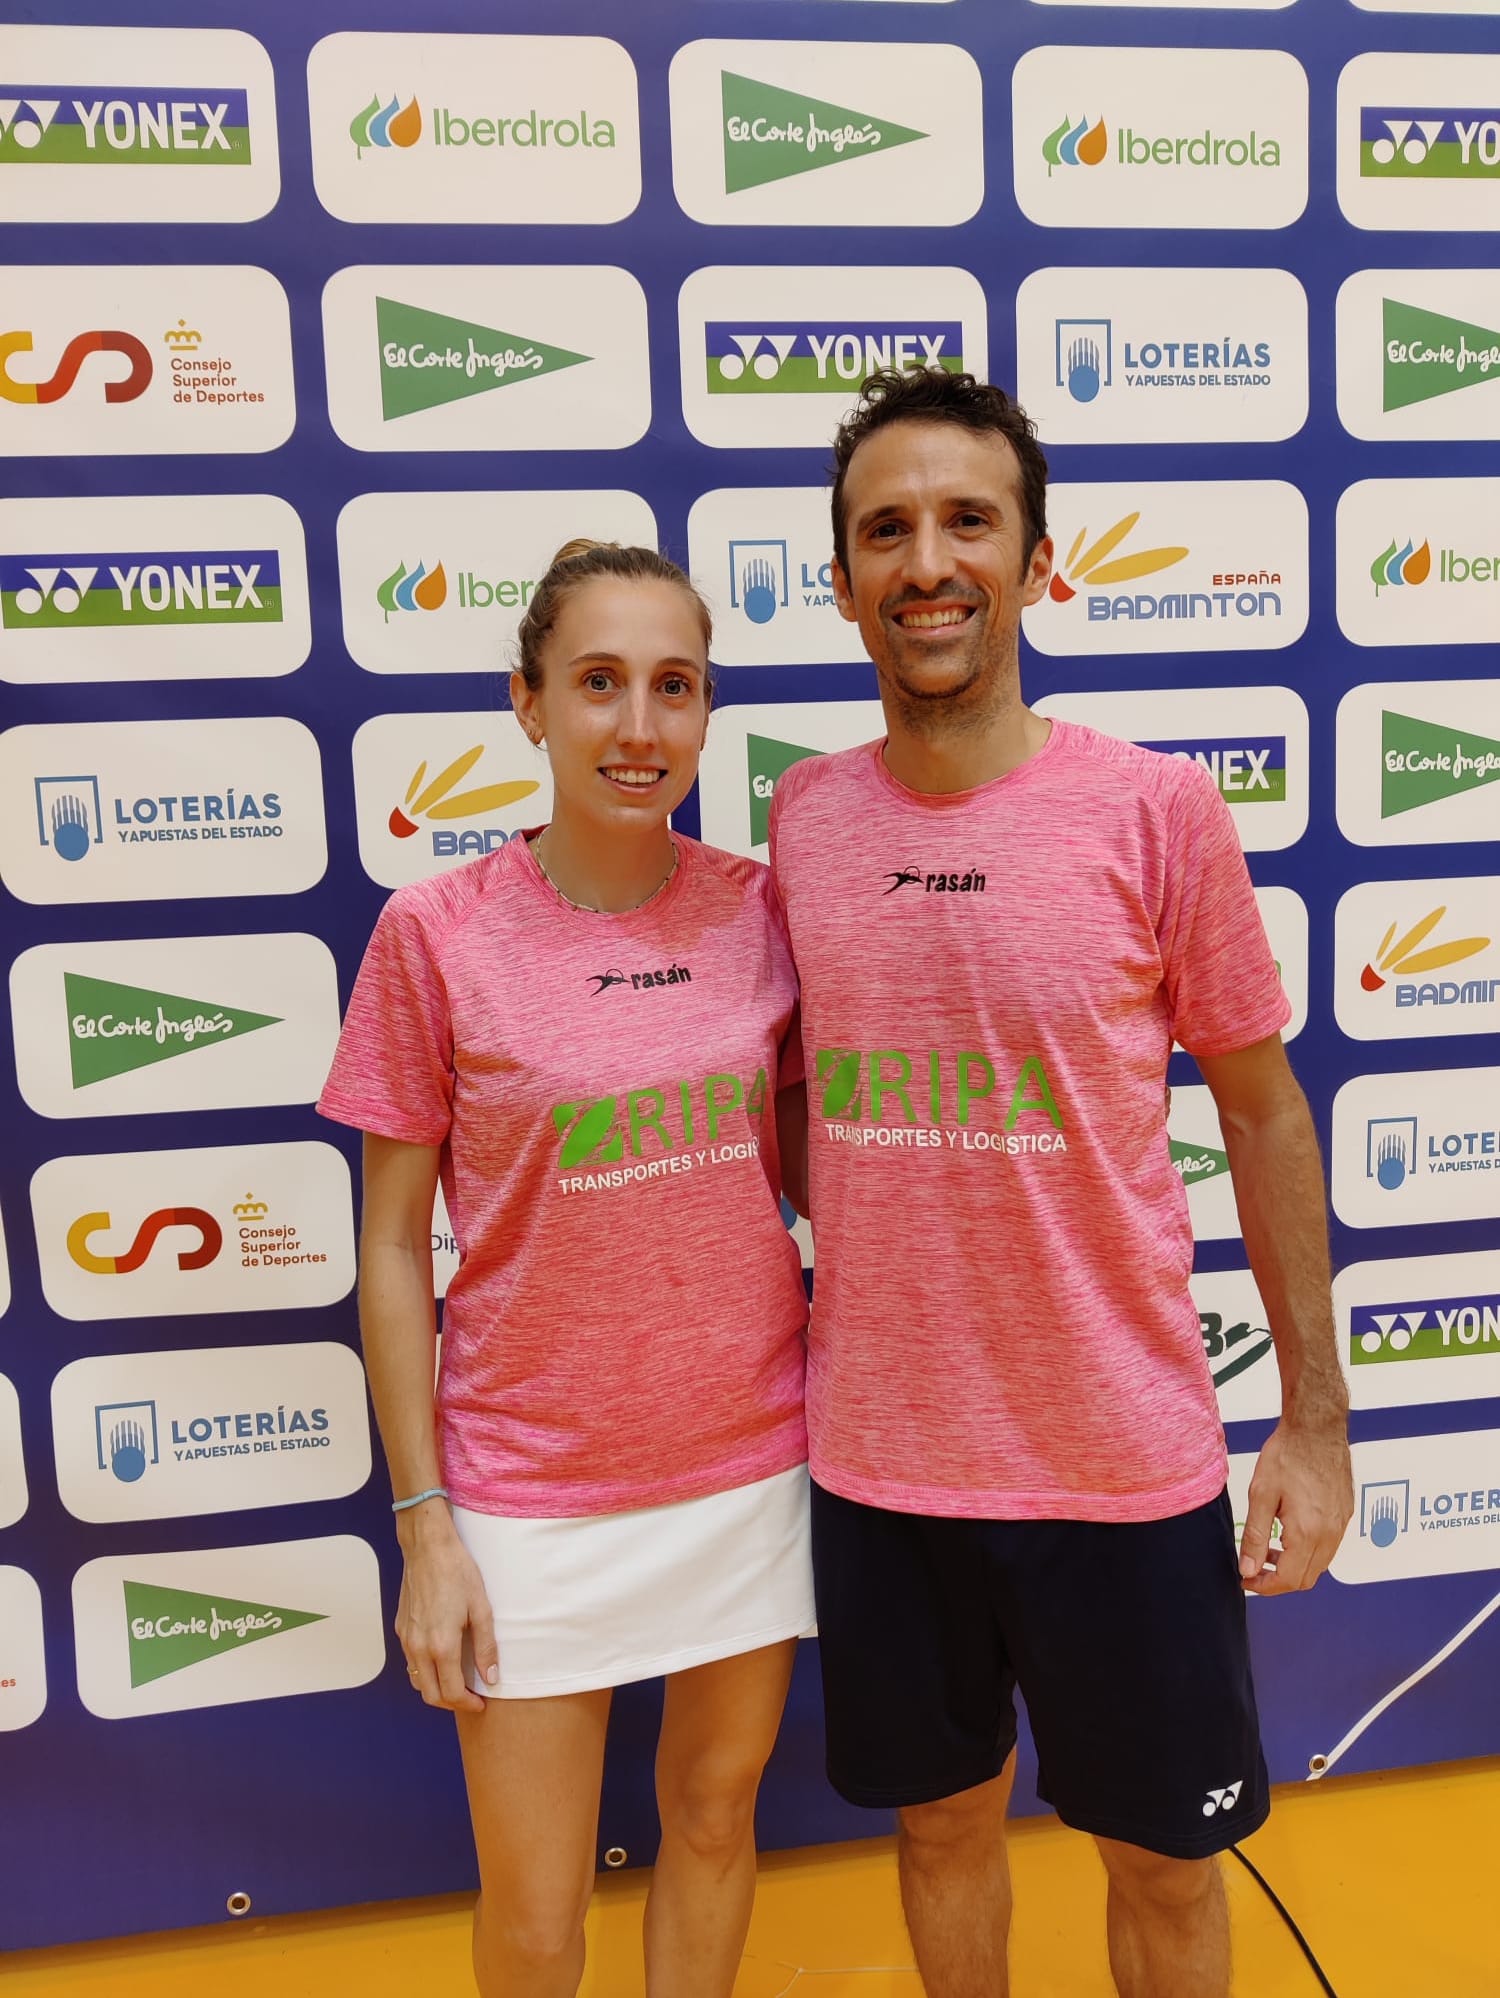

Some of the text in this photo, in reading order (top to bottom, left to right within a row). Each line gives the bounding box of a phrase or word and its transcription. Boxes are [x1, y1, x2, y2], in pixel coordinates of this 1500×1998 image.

[72, 100, 232, 150] YONEX
[433, 108, 616, 147] Iberdrola
[727, 113, 881, 152] El Corte Inglés
[1118, 128, 1281, 166] Iberdrola
[383, 338, 543, 378] El Corte Inglés
[1124, 337, 1271, 369] LOTERÍAS
[1387, 340, 1407, 363] El
[1408, 341, 1455, 364] Corte
[170, 358, 232, 374] Consejo
[172, 374, 237, 390] Superior
[1199, 374, 1222, 386] DEL
[1224, 374, 1271, 386] ESTADO
[173, 390, 265, 405] de Deportes
[109, 564, 264, 611] YONEX
[1213, 570, 1281, 585] ESPAÑA
[1088, 592, 1281, 621] BADMINTON
[1385, 750, 1405, 772] El
[1406, 750, 1452, 772] Corte
[753, 775, 774, 798] El
[114, 788, 282, 824] LOTERÍAS
[202, 827, 227, 840] DEL
[230, 826, 283, 839] ESTADO
[432, 829, 521, 856] BAD
[925, 867, 986, 893] rasán
[631, 963, 692, 990] rasán
[73, 1006, 233, 1044] El Corte Inglés
[869, 1050, 1065, 1131] RIPA
[825, 1123, 1068, 1155] TRANSPORTES Y LOGISTICA
[1428, 1131, 1500, 1157] LOTE
[558, 1156, 692, 1195] TRANSPORTES
[696, 1149, 706, 1167] Y
[239, 1225, 296, 1239] Consejo
[241, 1239, 301, 1254] Superior
[241, 1253, 327, 1267] de Deportes
[171, 1405, 329, 1444] LOTERÍAS
[253, 1441, 277, 1453] DEL
[280, 1436, 330, 1450] ESTADO
[131, 1607, 282, 1641] El Corte Inglés
